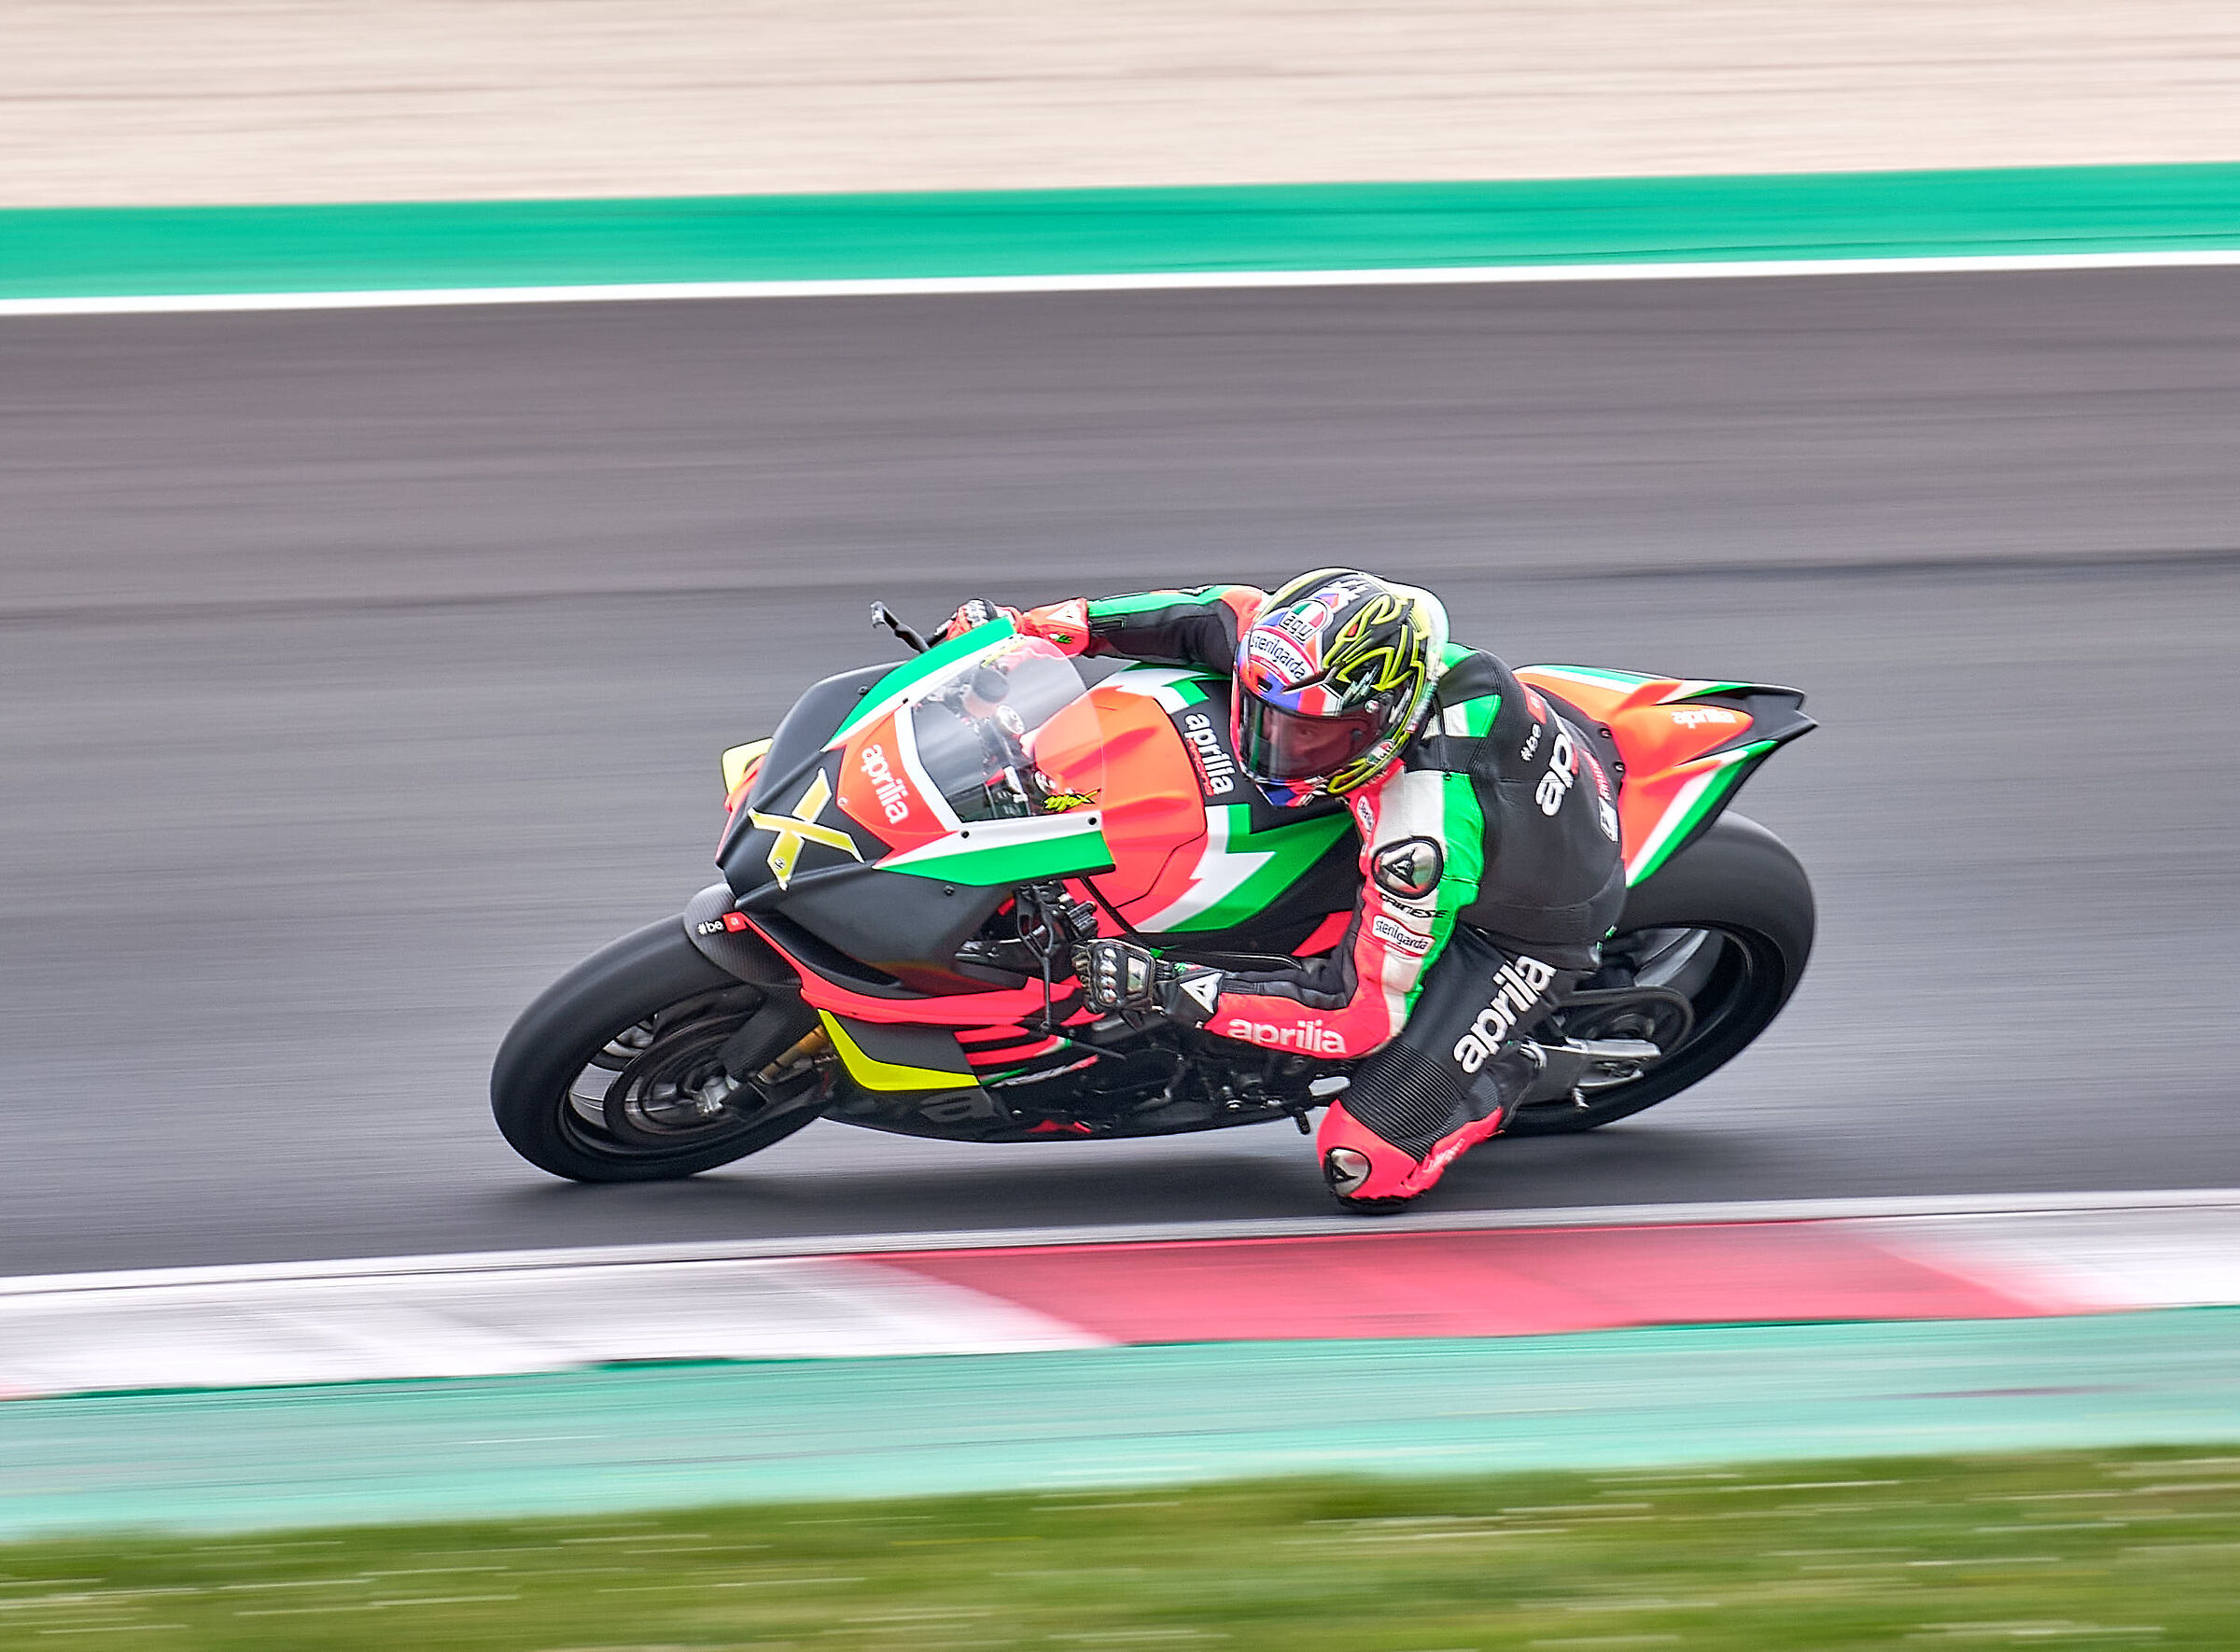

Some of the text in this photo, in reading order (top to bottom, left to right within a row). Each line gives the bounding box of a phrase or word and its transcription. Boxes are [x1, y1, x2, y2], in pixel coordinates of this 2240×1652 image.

[1250, 635, 1307, 679] sterilgarda
[1671, 708, 1736, 729] aprilia
[1183, 713, 1235, 795] aprilia
[861, 744, 909, 825] aprilia
[1375, 918, 1429, 951] sterilgarda
[1228, 1018, 1347, 1054] aprilia
[1453, 956, 1558, 1074] aprilia
